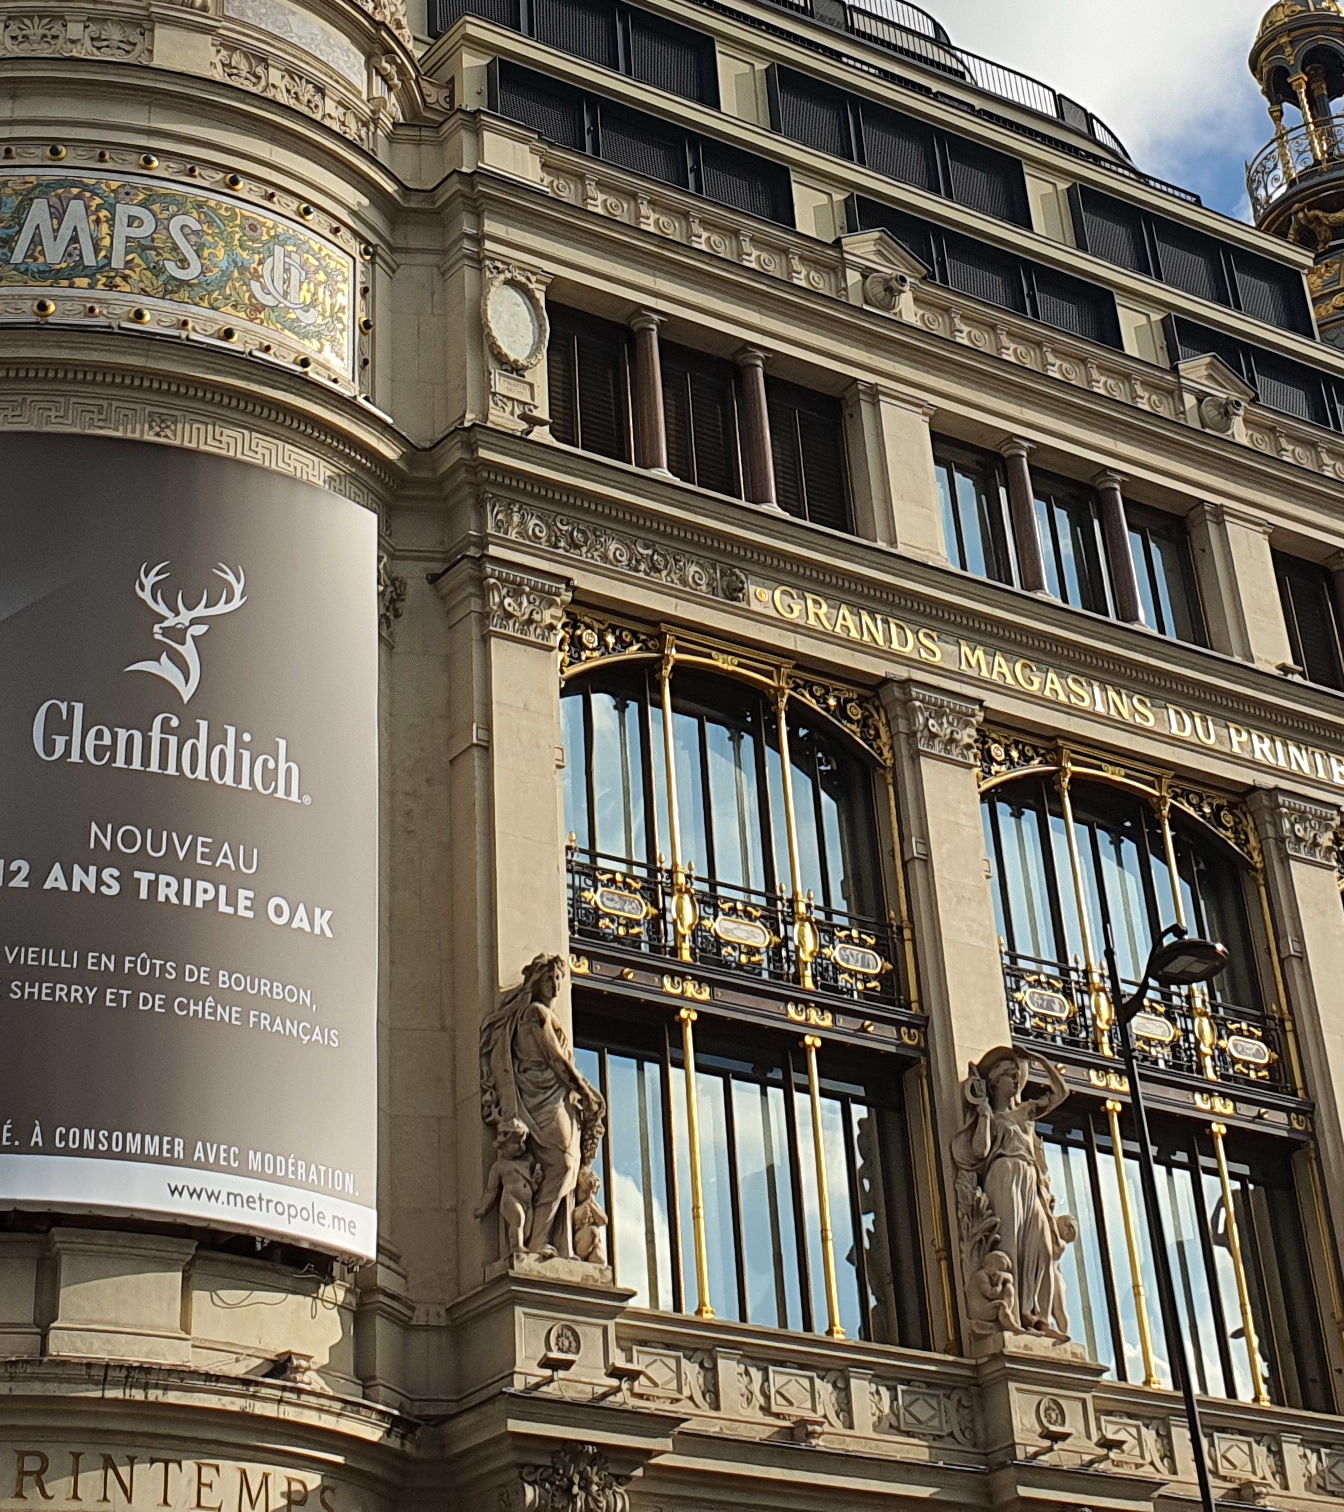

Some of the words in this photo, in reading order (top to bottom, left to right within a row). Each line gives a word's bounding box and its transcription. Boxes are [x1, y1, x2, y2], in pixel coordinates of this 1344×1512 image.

[773, 585, 942, 663] GRANDS
[958, 639, 1155, 729] MAGASINS
[1164, 703, 1216, 746] DU
[32, 699, 302, 804] Glenfiddich
[89, 821, 259, 874] NOUVEAU
[43, 862, 121, 896] ANS
[133, 870, 255, 918] TRIPLE
[267, 896, 334, 938] OAK
[4, 945, 78, 969] VIEILLI
[87, 952, 115, 973] EN
[124, 952, 177, 980] FÛTS
[184, 964, 210, 986] DE
[218, 970, 317, 1013] BOURBON,
[9, 981, 98, 1005] SHERRY
[105, 989, 132, 1009] ET
[138, 992, 167, 1013] DE
[174, 996, 242, 1026] CHÊNE
[248, 1011, 340, 1048] FRANÇAIS
[30, 1119, 44, 1148] À
[55, 1125, 185, 1161] CONSOMMER
[193, 1140, 240, 1168] AVEC
[248, 1149, 361, 1198] MODÉRATION.
[167, 1181, 358, 1237] www.metropole.me
